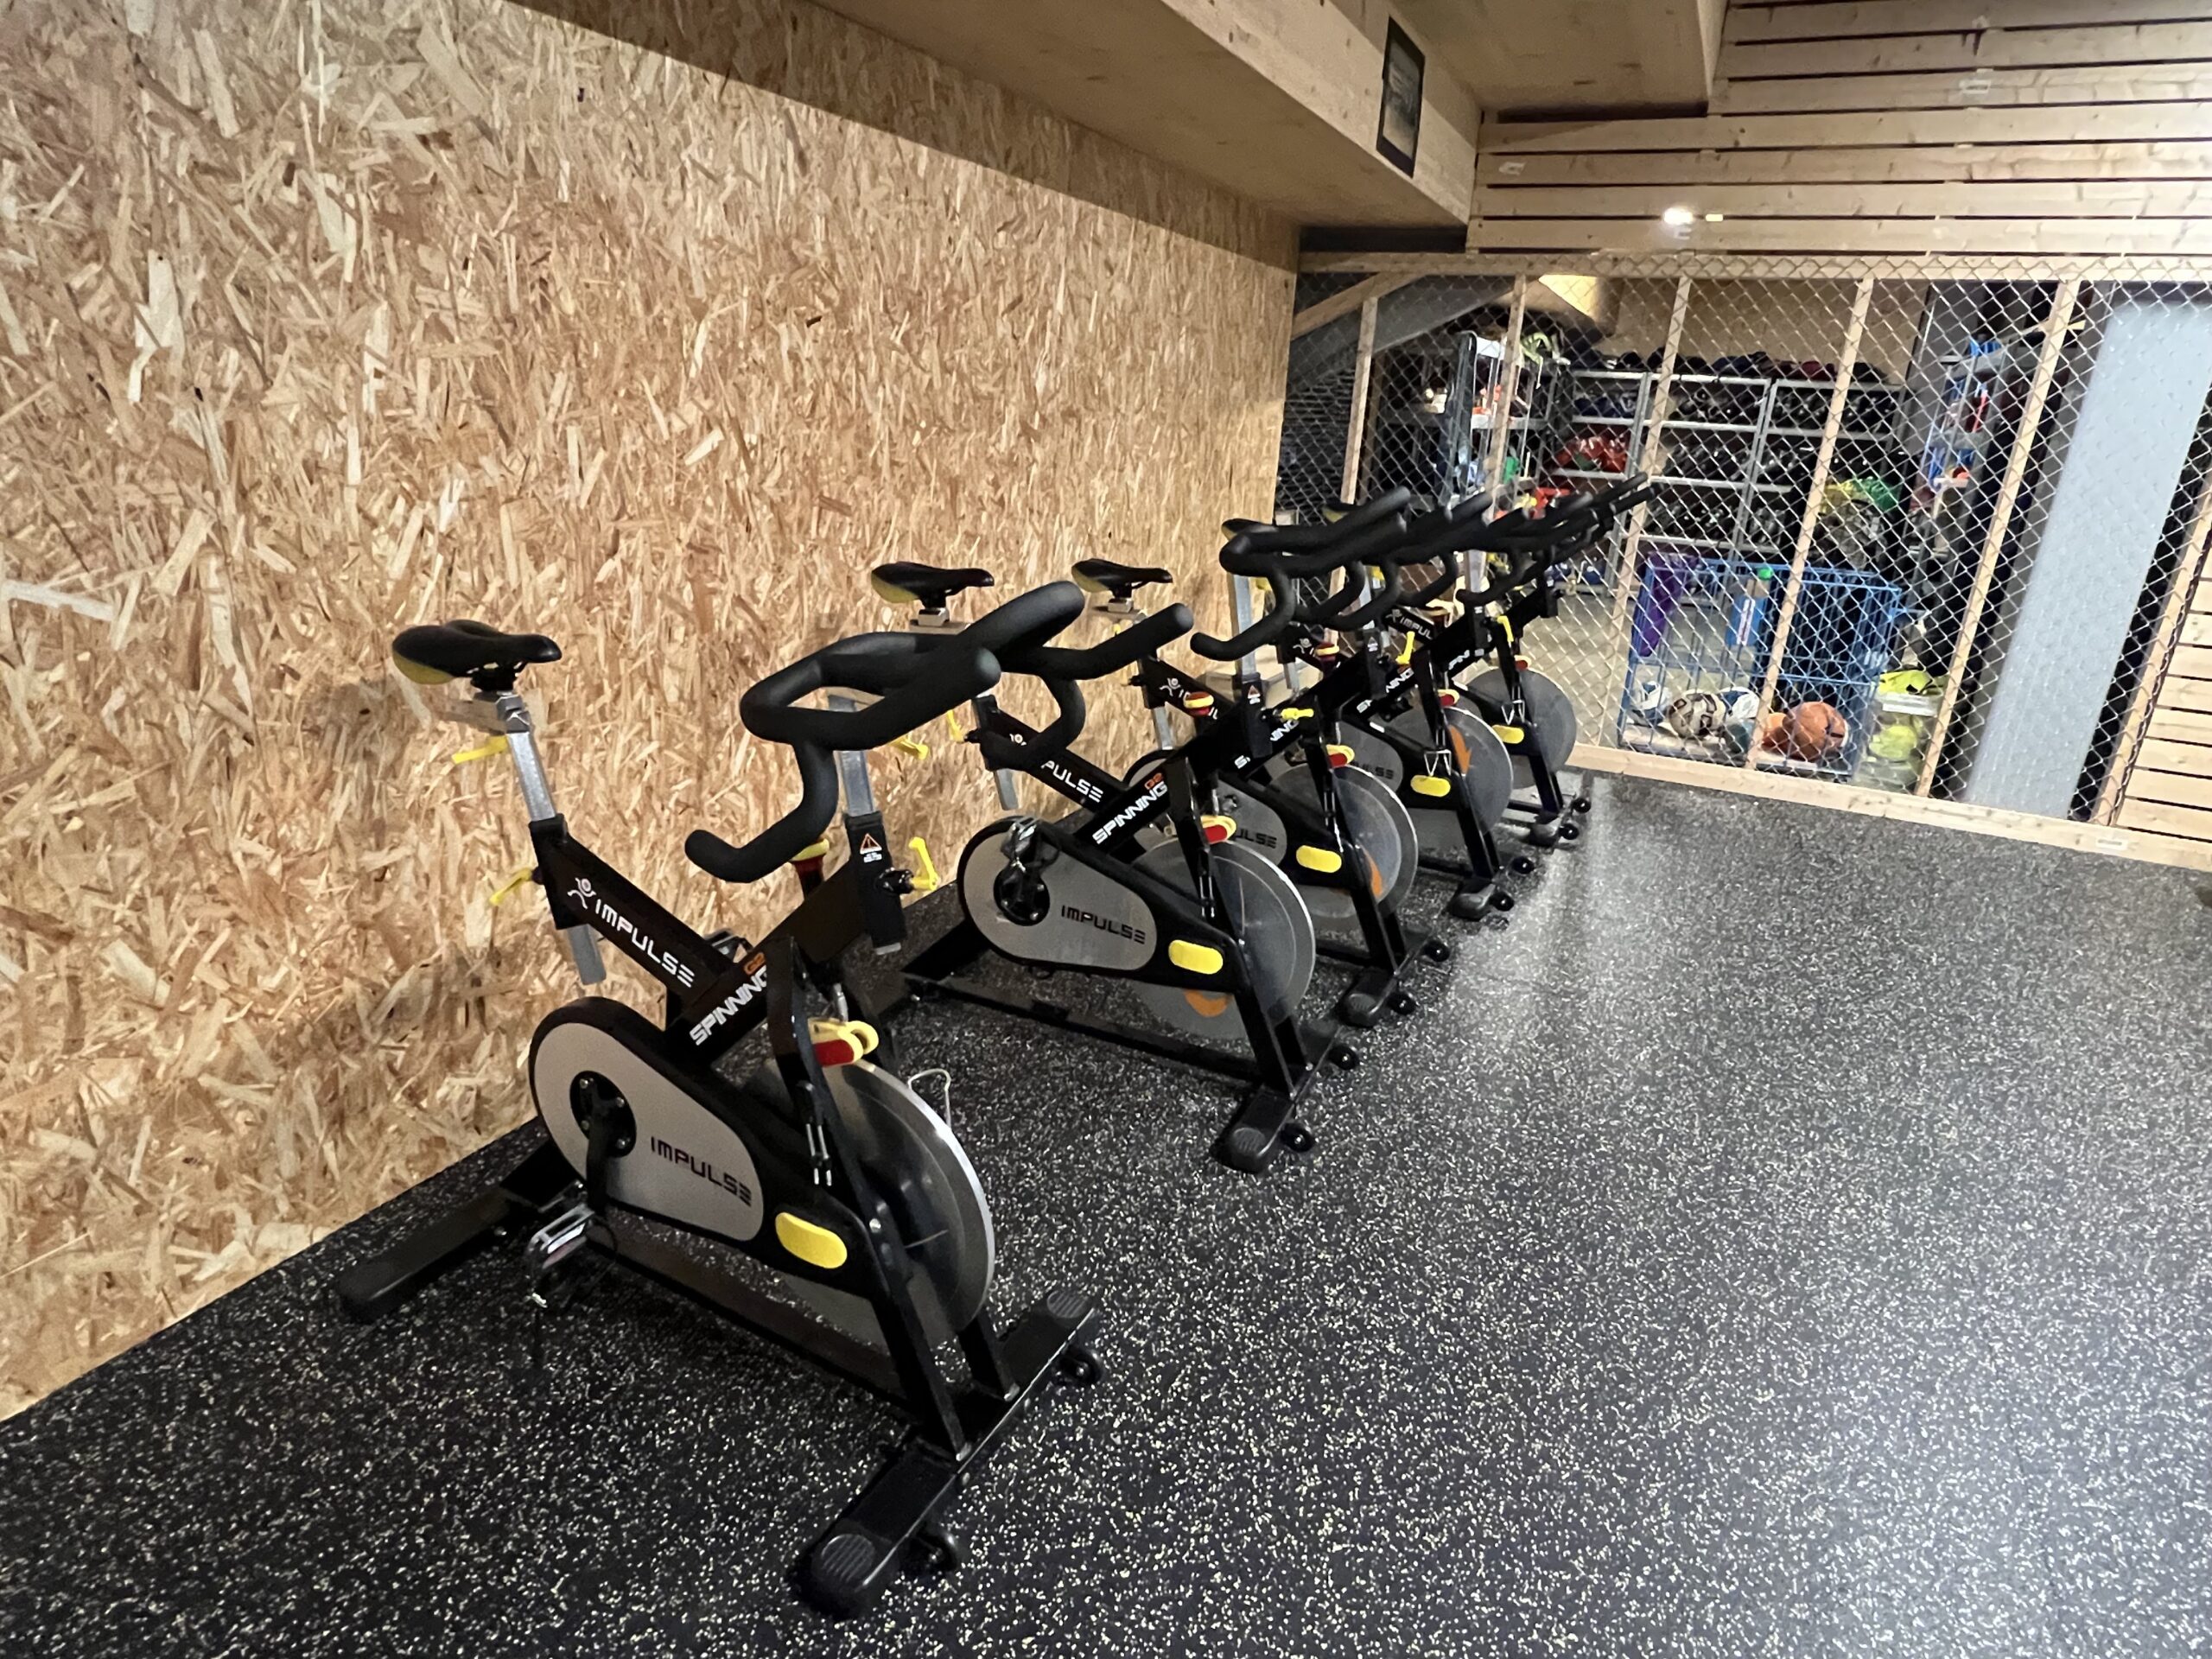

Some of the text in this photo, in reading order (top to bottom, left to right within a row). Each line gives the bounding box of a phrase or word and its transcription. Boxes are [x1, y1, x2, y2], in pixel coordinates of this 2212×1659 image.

[1400, 616, 1433, 640] IMPUL
[1040, 760, 1103, 803] PULSE
[1092, 780, 1168, 844] SPINNING
[595, 899, 695, 988] IMPULSE
[1061, 905, 1146, 944] IMPULSE
[651, 1136, 752, 1207] IMPULSE
